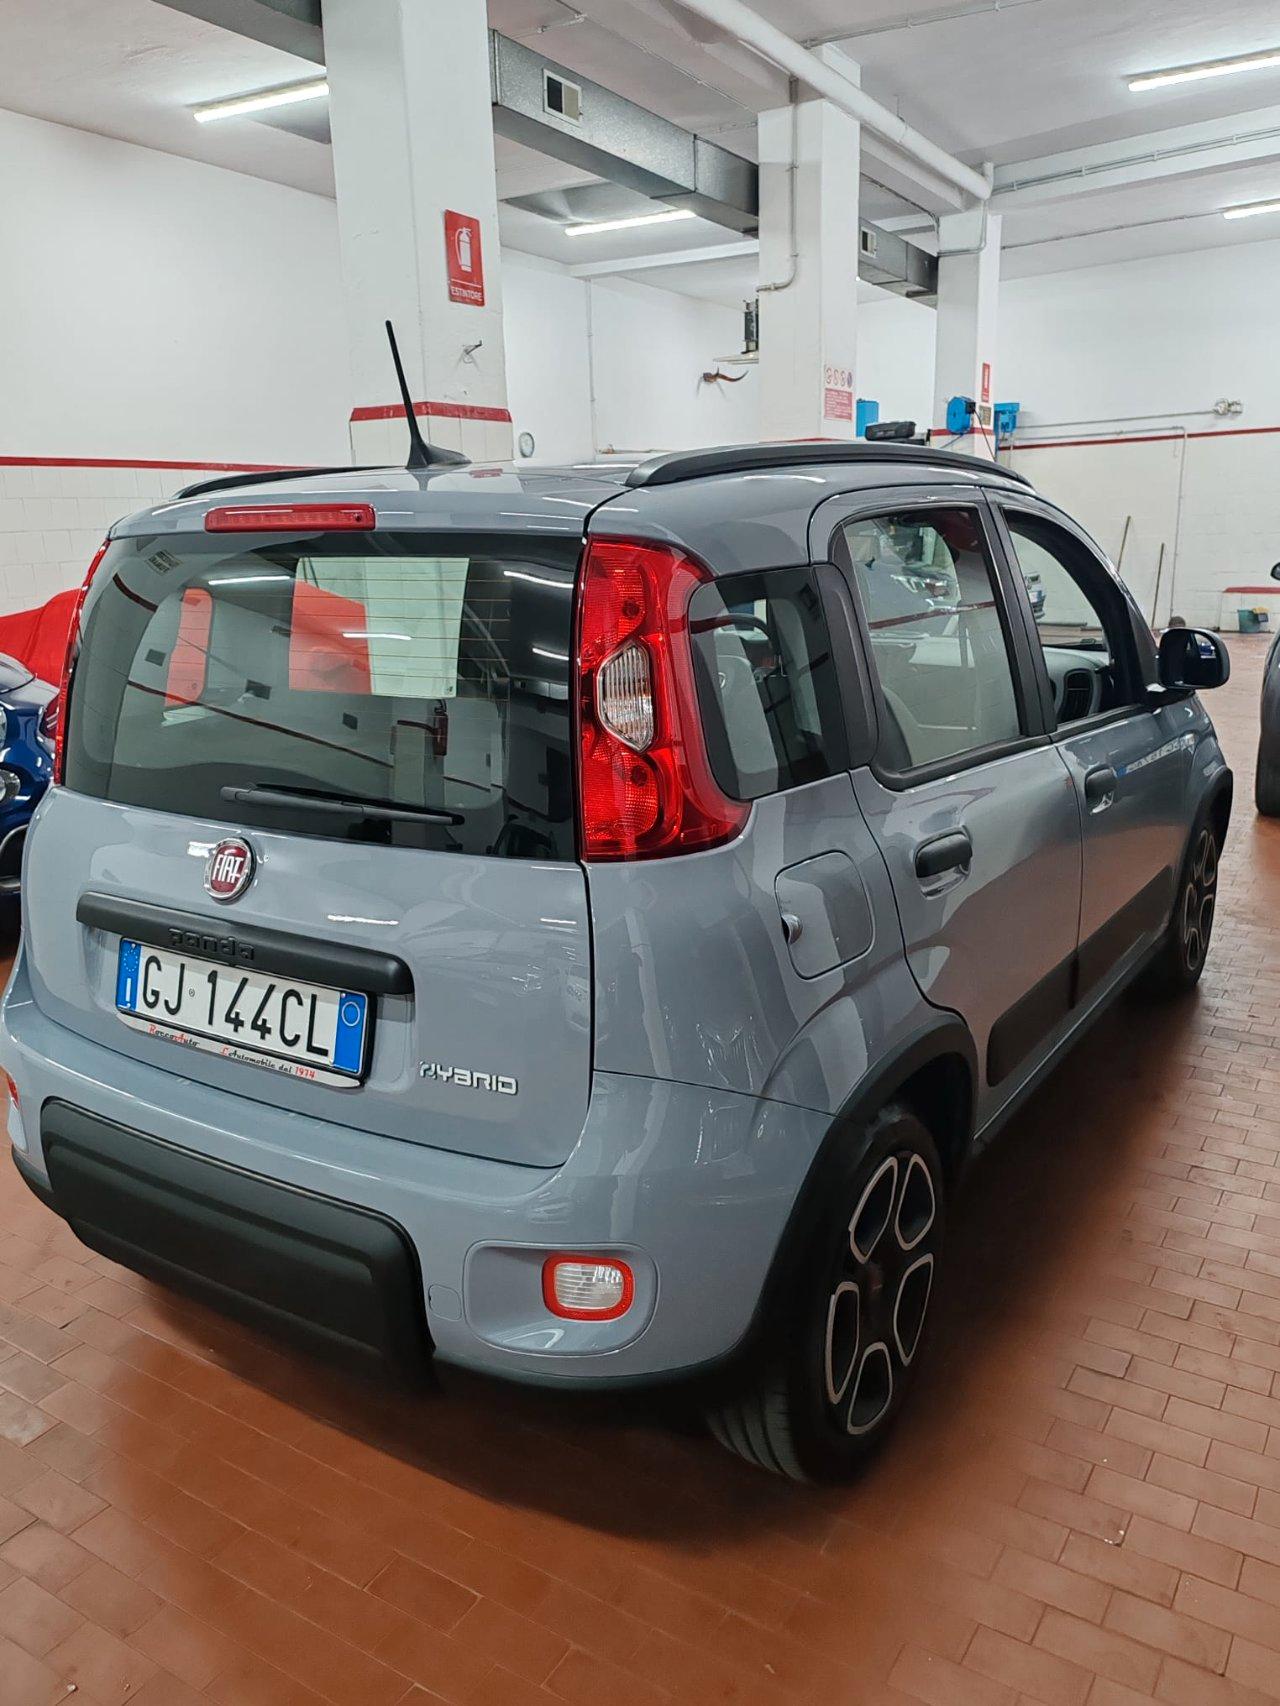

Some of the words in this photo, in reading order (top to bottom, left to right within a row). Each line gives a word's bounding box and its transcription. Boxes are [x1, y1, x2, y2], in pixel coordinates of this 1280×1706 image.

[451, 286, 483, 302] ESTINTORE
[212, 853, 244, 884] FIAT
[420, 1060, 518, 1095] HYBRID
